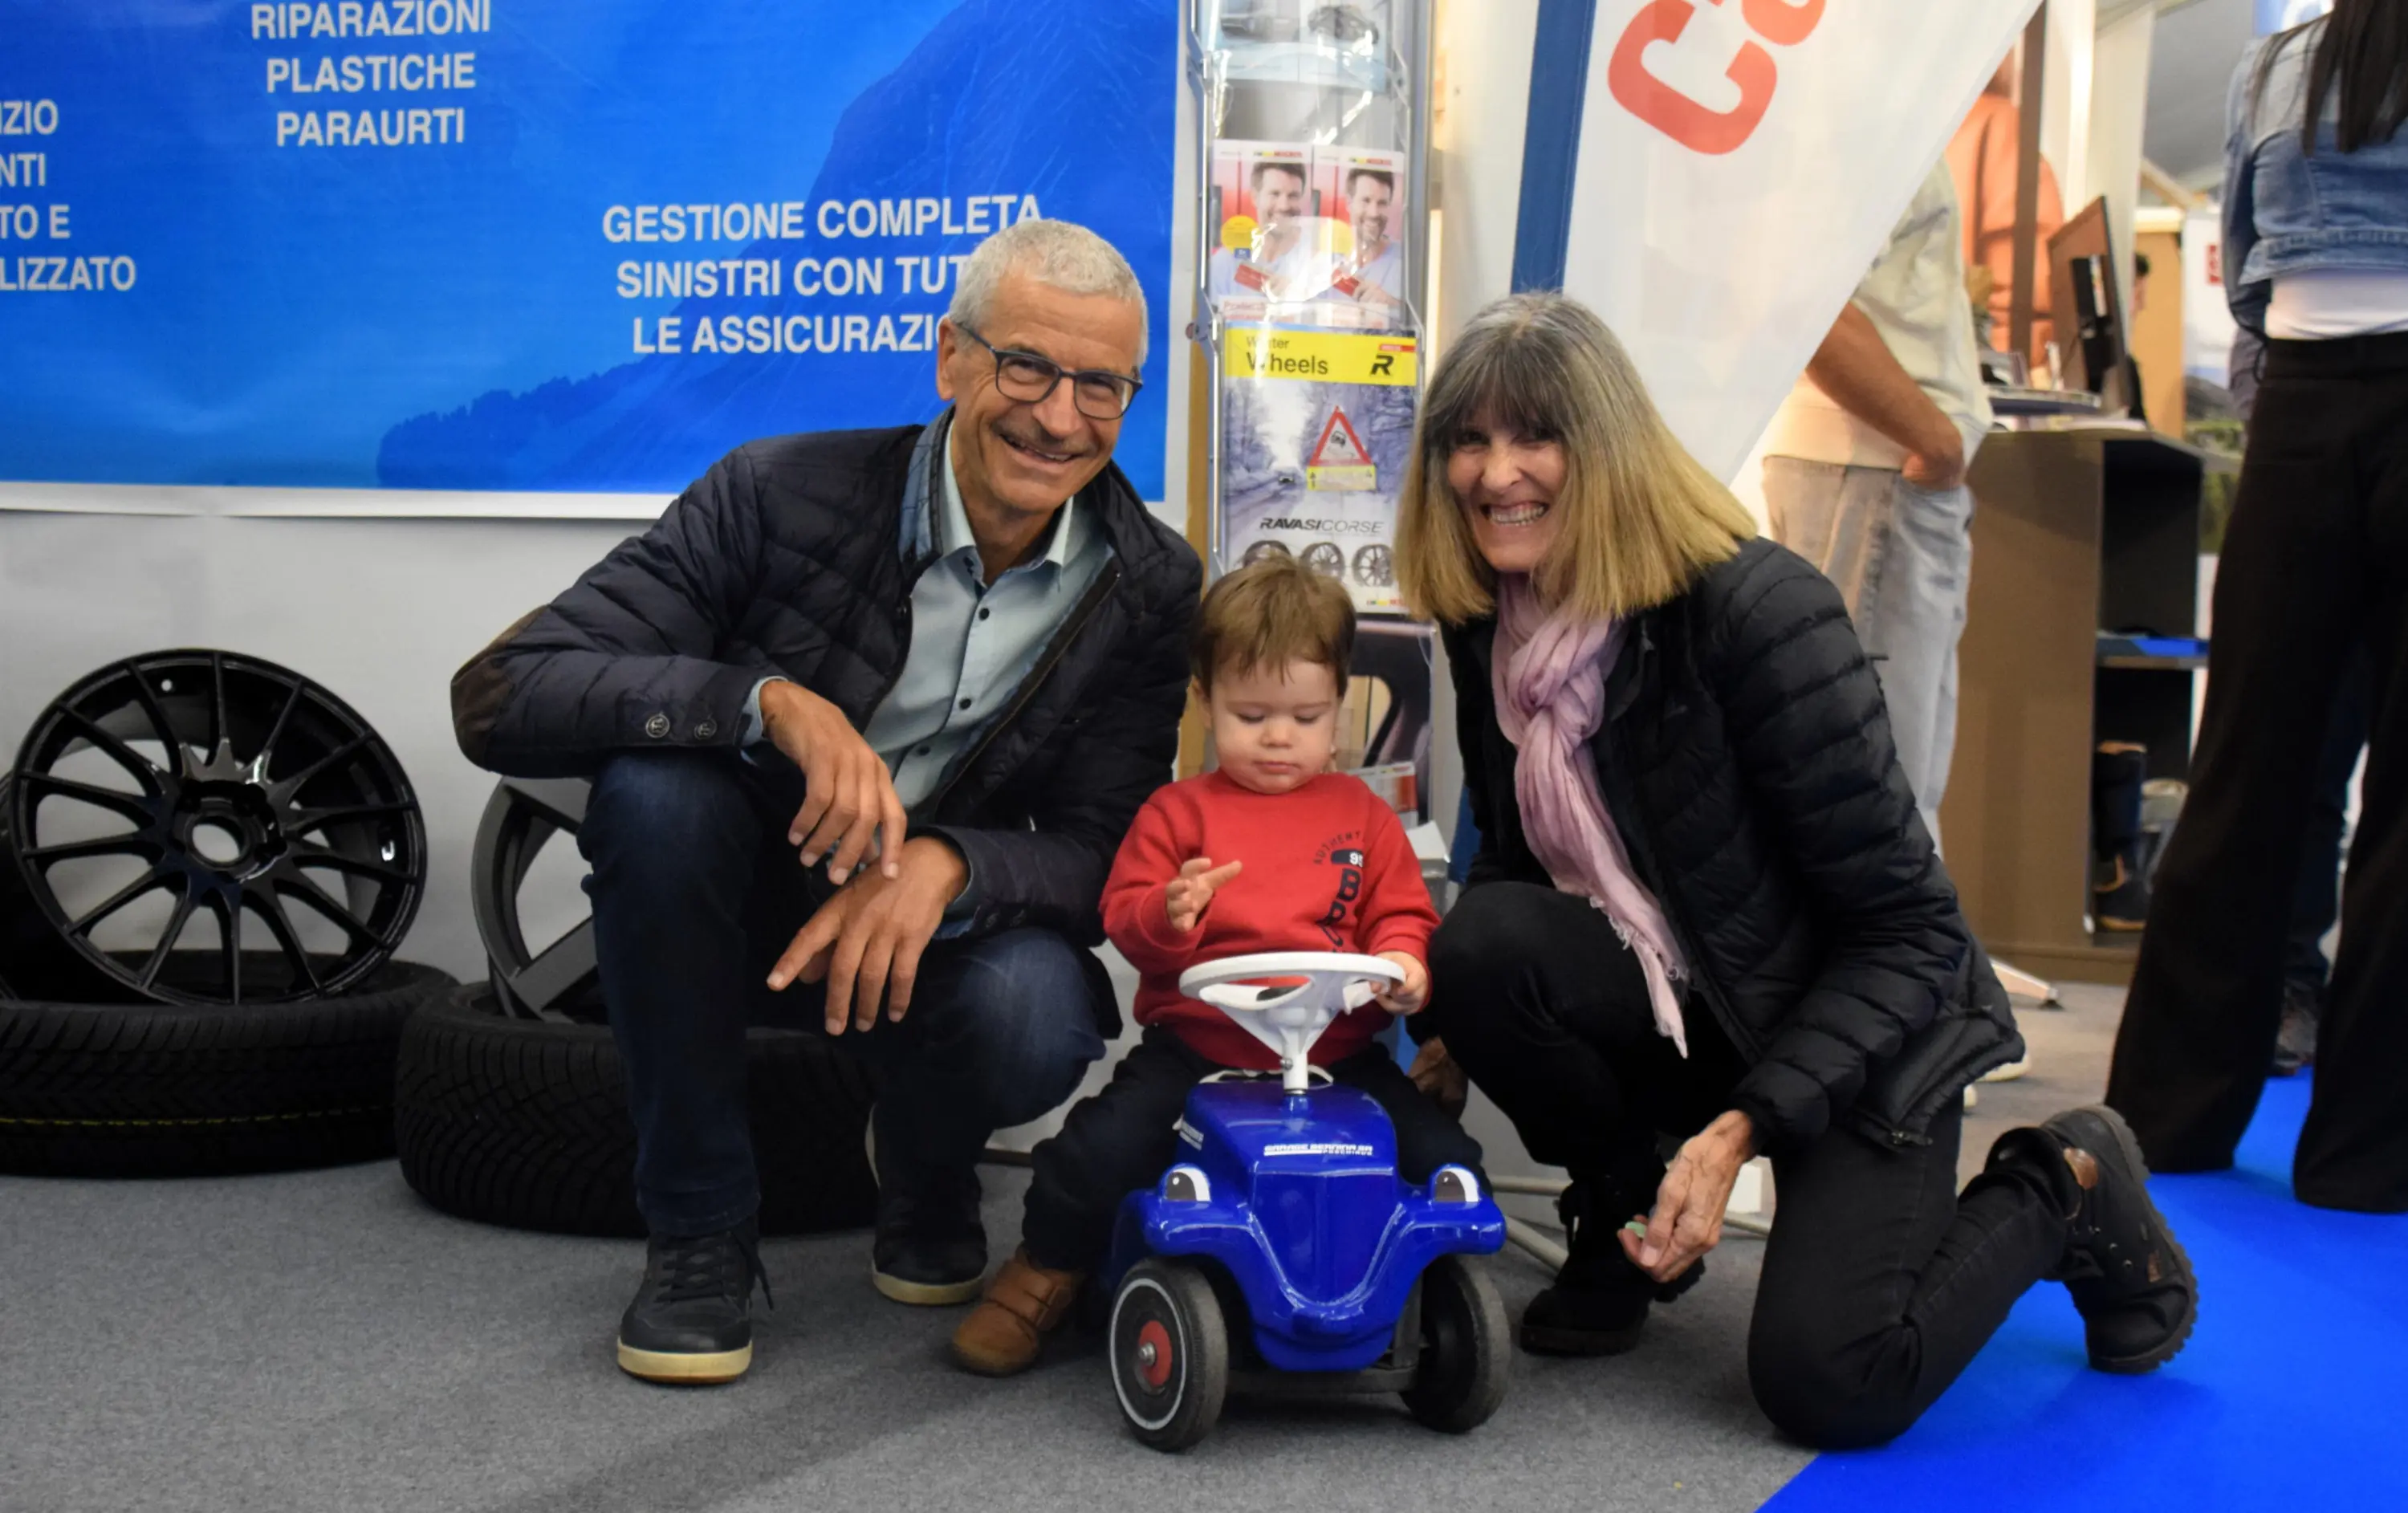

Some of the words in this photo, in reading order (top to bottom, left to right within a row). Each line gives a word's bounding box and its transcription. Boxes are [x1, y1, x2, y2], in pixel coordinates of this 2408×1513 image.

[251, 0, 491, 39] RIPARAZIONI
[266, 51, 477, 94] PLASTICHE
[276, 107, 466, 147] PARAURTI
[49, 204, 71, 239] E
[602, 203, 805, 242] GESTIONE
[817, 194, 1041, 239] COMPLETA
[0, 255, 136, 291] LIZZATO
[616, 257, 780, 298] SINISTRI
[794, 256, 882, 296] CON
[895, 254, 971, 295] TUT
[633, 317, 681, 354] LE
[691, 313, 947, 353] ASSICURAZI
[1246, 351, 1328, 375] Wheels
